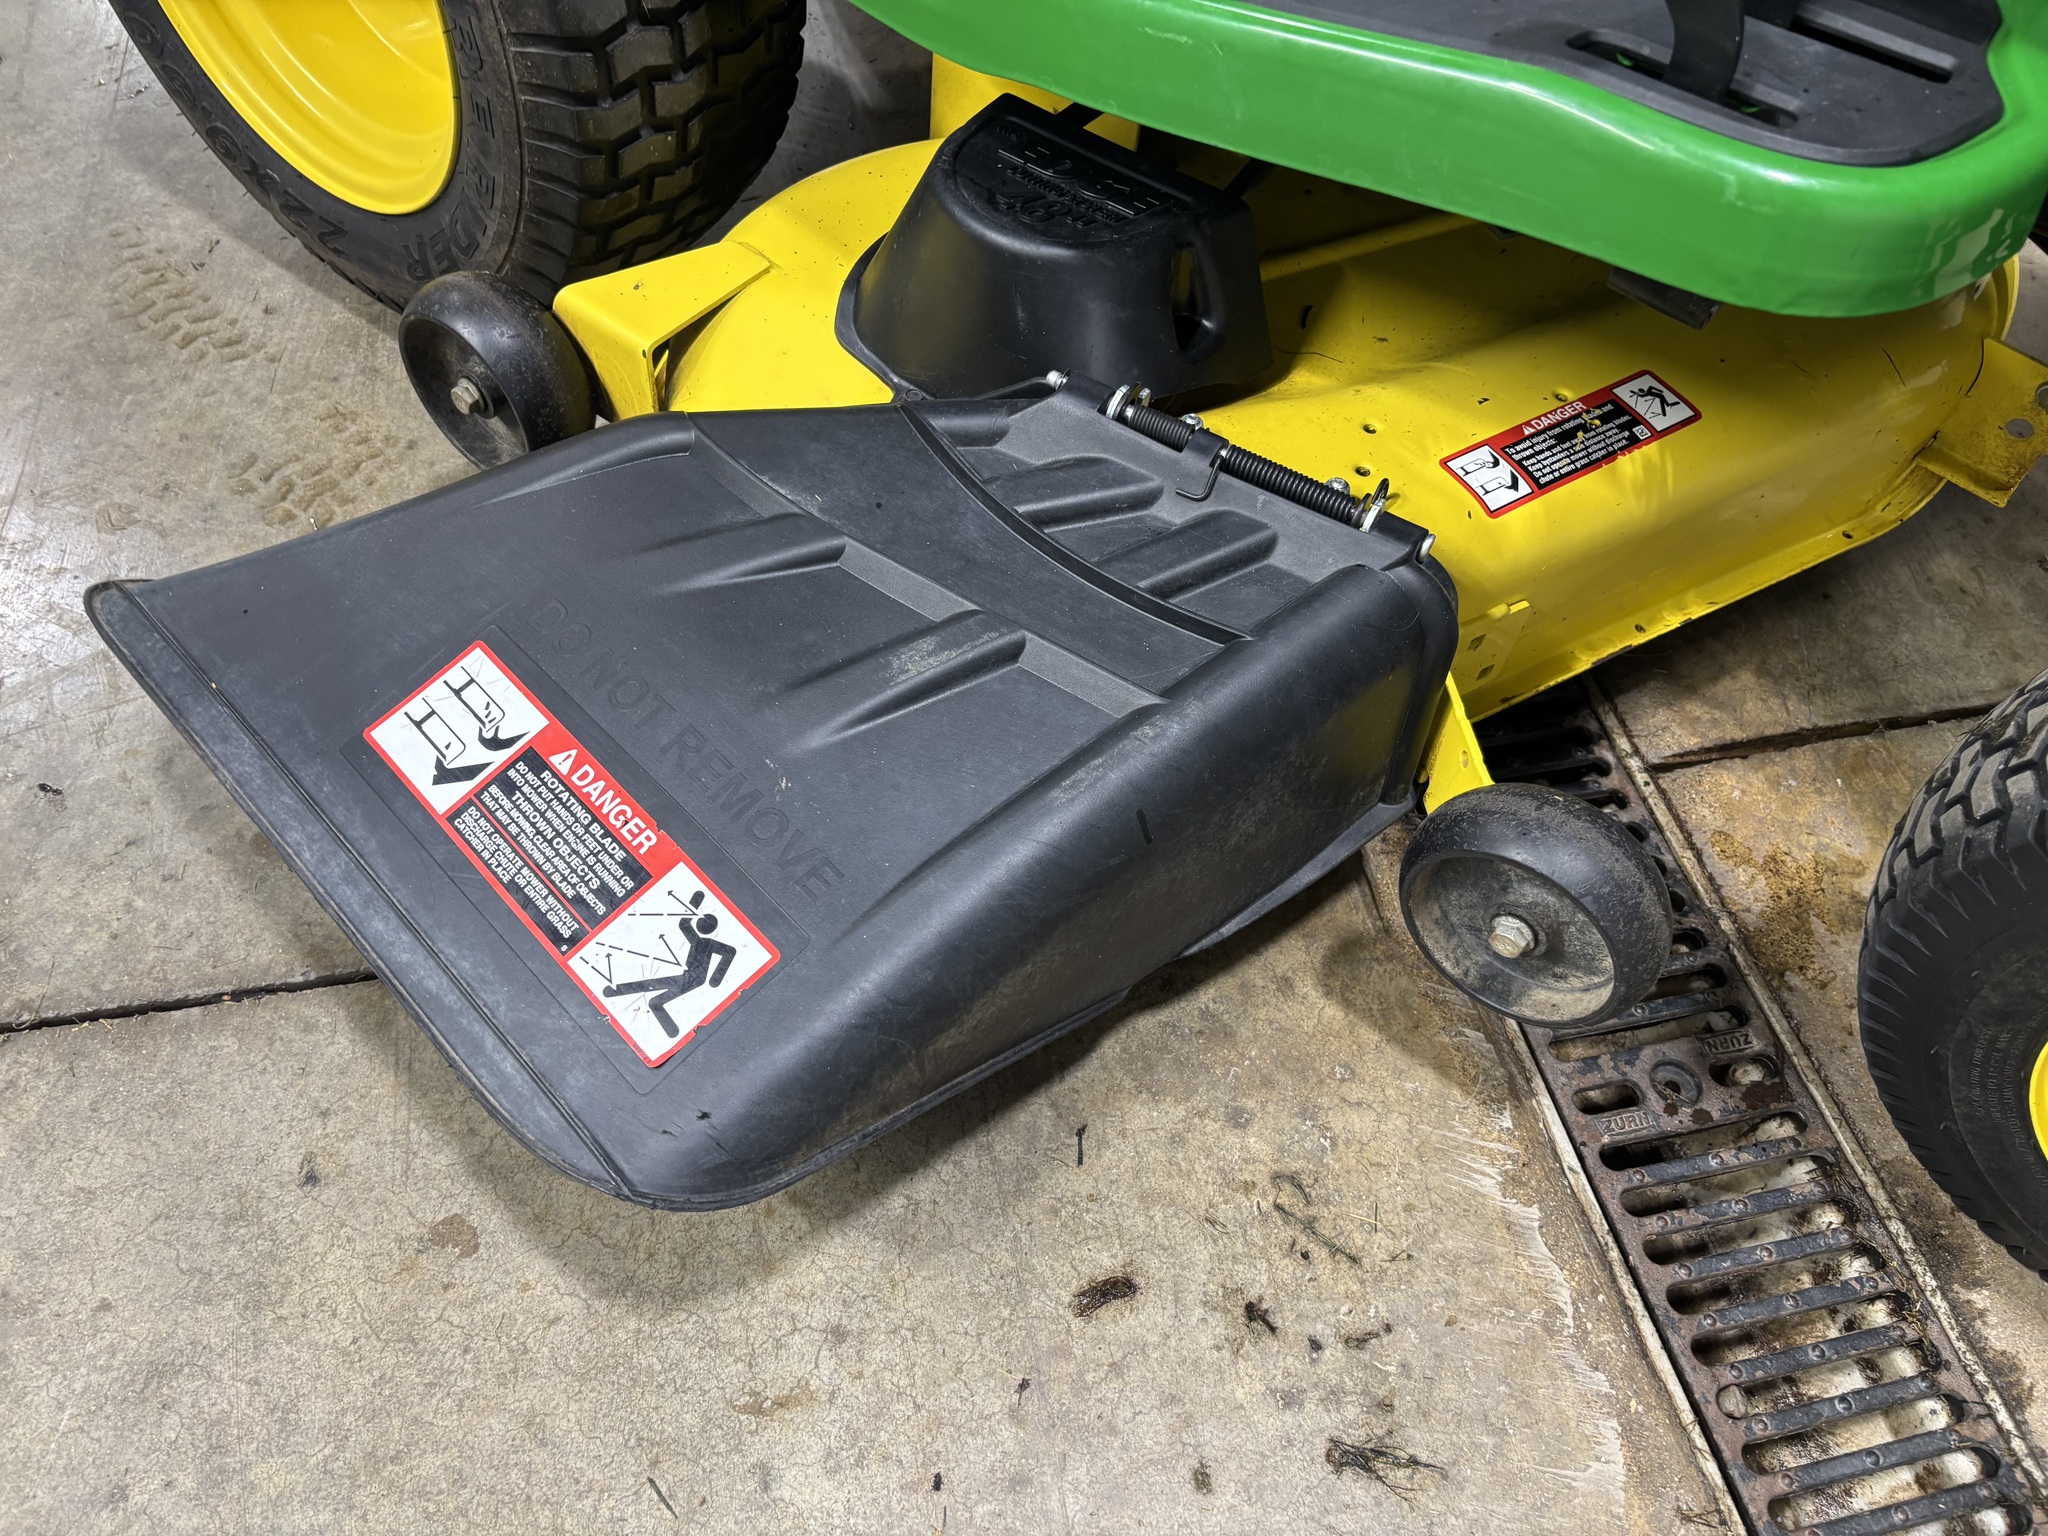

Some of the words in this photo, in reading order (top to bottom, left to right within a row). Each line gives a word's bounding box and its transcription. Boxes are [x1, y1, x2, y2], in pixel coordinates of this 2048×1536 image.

[1514, 440, 1532, 451] avoid
[1530, 433, 1549, 444] injury
[1546, 427, 1562, 436] from
[1561, 418, 1585, 430] rotating
[1601, 404, 1613, 412] and
[1522, 457, 1537, 466] Keep
[1536, 451, 1552, 460] hands
[1551, 445, 1561, 454] and
[1560, 441, 1572, 449] feet
[1583, 430, 1596, 438] from
[1595, 422, 1616, 433] rotating
[1614, 415, 1631, 425] blades.
[1531, 402, 1586, 430] DANGER
[1570, 450, 1587, 460] mower
[1587, 441, 1606, 453] without
[1605, 431, 1630, 444] discharge
[1512, 448, 1534, 460] thrown
[1533, 438, 1557, 451] objects:
[1528, 463, 1543, 472] Keep
[1542, 451, 1570, 466] bystanders
[1584, 434, 1605, 446] distance
[1605, 428, 1619, 437] away.
[1539, 474, 1554, 484] chute
[1559, 464, 1575, 474] entire
[1575, 457, 1589, 468] grass
[1589, 449, 1607, 460] catcher
[1612, 439, 1629, 450] place.
[507, 768, 525, 786] INTO
[521, 784, 547, 812] MOWER
[545, 809, 566, 832] WHEN
[562, 829, 589, 858] ENGINE
[586, 855, 597, 865] IS
[593, 863, 625, 897] RUNNING
[512, 791, 555, 839] THROWN
[553, 838, 600, 889] OBJECTS
[515, 761, 528, 774] DO
[525, 771, 542, 788] NOT
[537, 785, 554, 801] PUT
[550, 799, 575, 825] HANDS
[571, 822, 585, 836] OR
[581, 833, 602, 853] FEET
[598, 851, 623, 878] UNDER
[620, 876, 634, 890] OR
[541, 770, 591, 825] ROTATING
[589, 823, 626, 862] BLADE
[570, 764, 658, 855] DANGER
[454, 818, 484, 852] CATCHER
[481, 849, 491, 860] IN
[488, 857, 511, 883] PLACE
[461, 813, 497, 853] DISCHARGE
[494, 851, 518, 876] CHUTE
[514, 874, 527, 888] OR
[524, 885, 550, 913] ENTIRE
[547, 911, 572, 938] GRASS
[467, 806, 481, 819] DO
[477, 817, 494, 834] NOT
[491, 833, 524, 869] OPERATE
[520, 867, 548, 897] MOWER
[546, 895, 579, 930] WITHOUT
[480, 791, 499, 811] THAT
[495, 809, 512, 825] MAY
[507, 823, 520, 836] BE
[517, 833, 546, 865] THROWN
[542, 861, 556, 874] BY
[551, 872, 576, 898] BLADE
[488, 785, 513, 812] BEFORE
[510, 809, 536, 839] MOWING,
[533, 835, 555, 859] CLEAR
[551, 856, 571, 877] AREA
[567, 873, 580, 884] OF
[576, 883, 606, 915] OBJECTS
[1702, 1033, 1752, 1053] ZURN
[1601, 1110, 1652, 1135] ZURN
